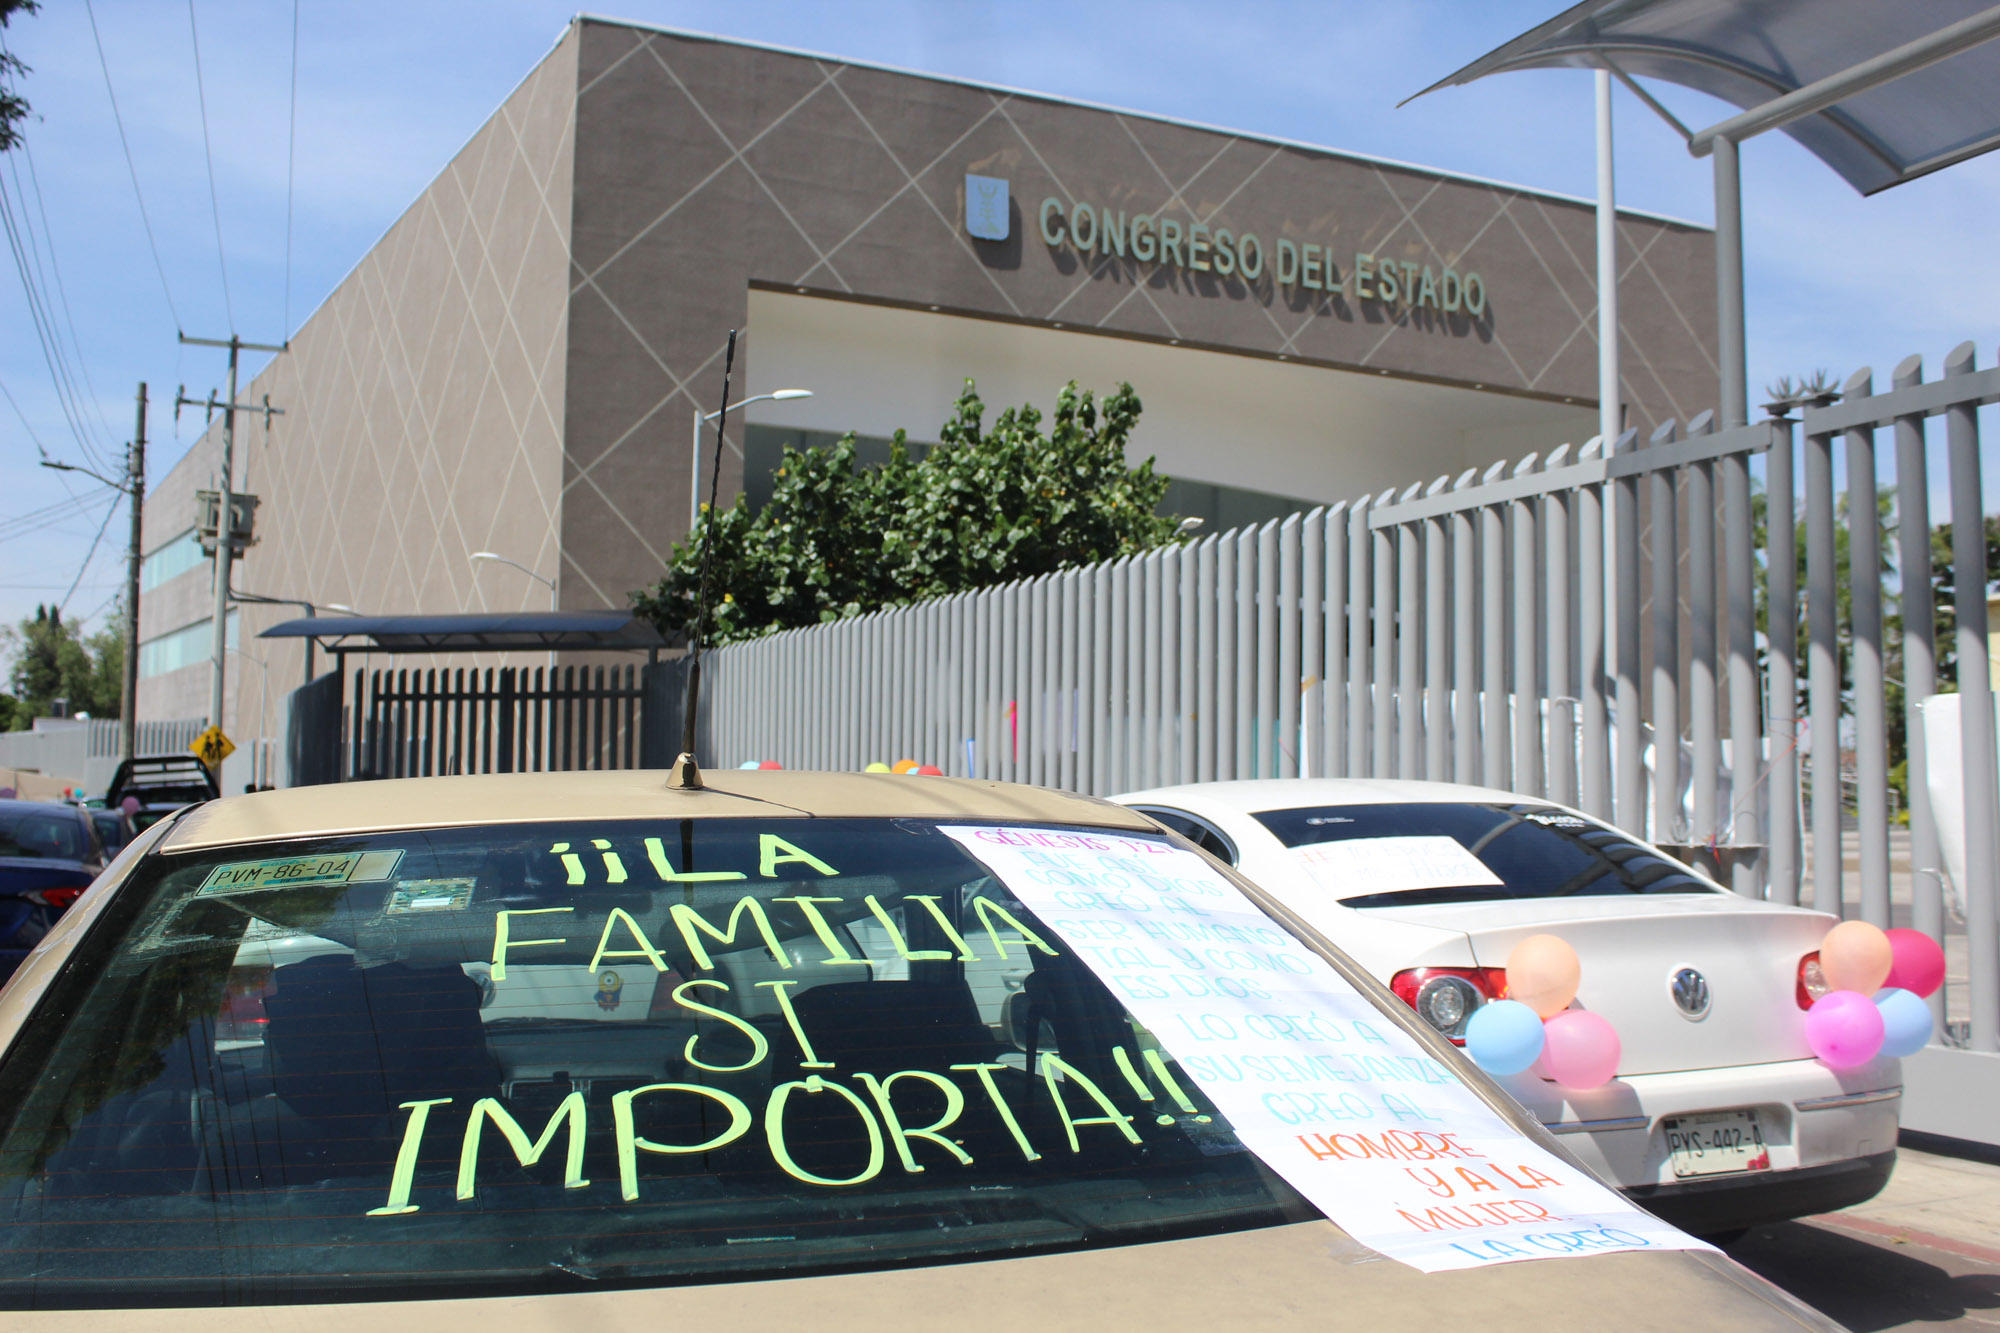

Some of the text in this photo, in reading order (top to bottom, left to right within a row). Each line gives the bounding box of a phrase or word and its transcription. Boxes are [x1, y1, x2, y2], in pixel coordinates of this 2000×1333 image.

[1040, 198, 1485, 316] CONGRESO DEL ESTADO
[975, 829, 1110, 851] GÉNESIS
[213, 860, 350, 886] PVM-86-04
[1024, 868, 1224, 897] COMO DIOS
[1160, 896, 1211, 916] AL
[491, 896, 1059, 982] FAMILIA
[1054, 919, 1286, 947] SER HUMANO
[1078, 945, 1170, 969] TAL
[1204, 949, 1312, 975] COMO
[1112, 975, 1169, 999] ES
[672, 980, 835, 1071] SI
[1177, 1010, 1391, 1045] LO CREÓ A
[1184, 1054, 1243, 1082] SU
[1261, 1092, 1443, 1125] CREO AL
[366, 1046, 1211, 1215] IMPORTA!!
[1670, 1124, 1763, 1161] PYS-442-A
[1296, 1130, 1487, 1161] HOMBRE
[1454, 1166, 1500, 1192] A
[1488, 1164, 1565, 1190] LA
[1448, 1239, 1524, 1260] LA
